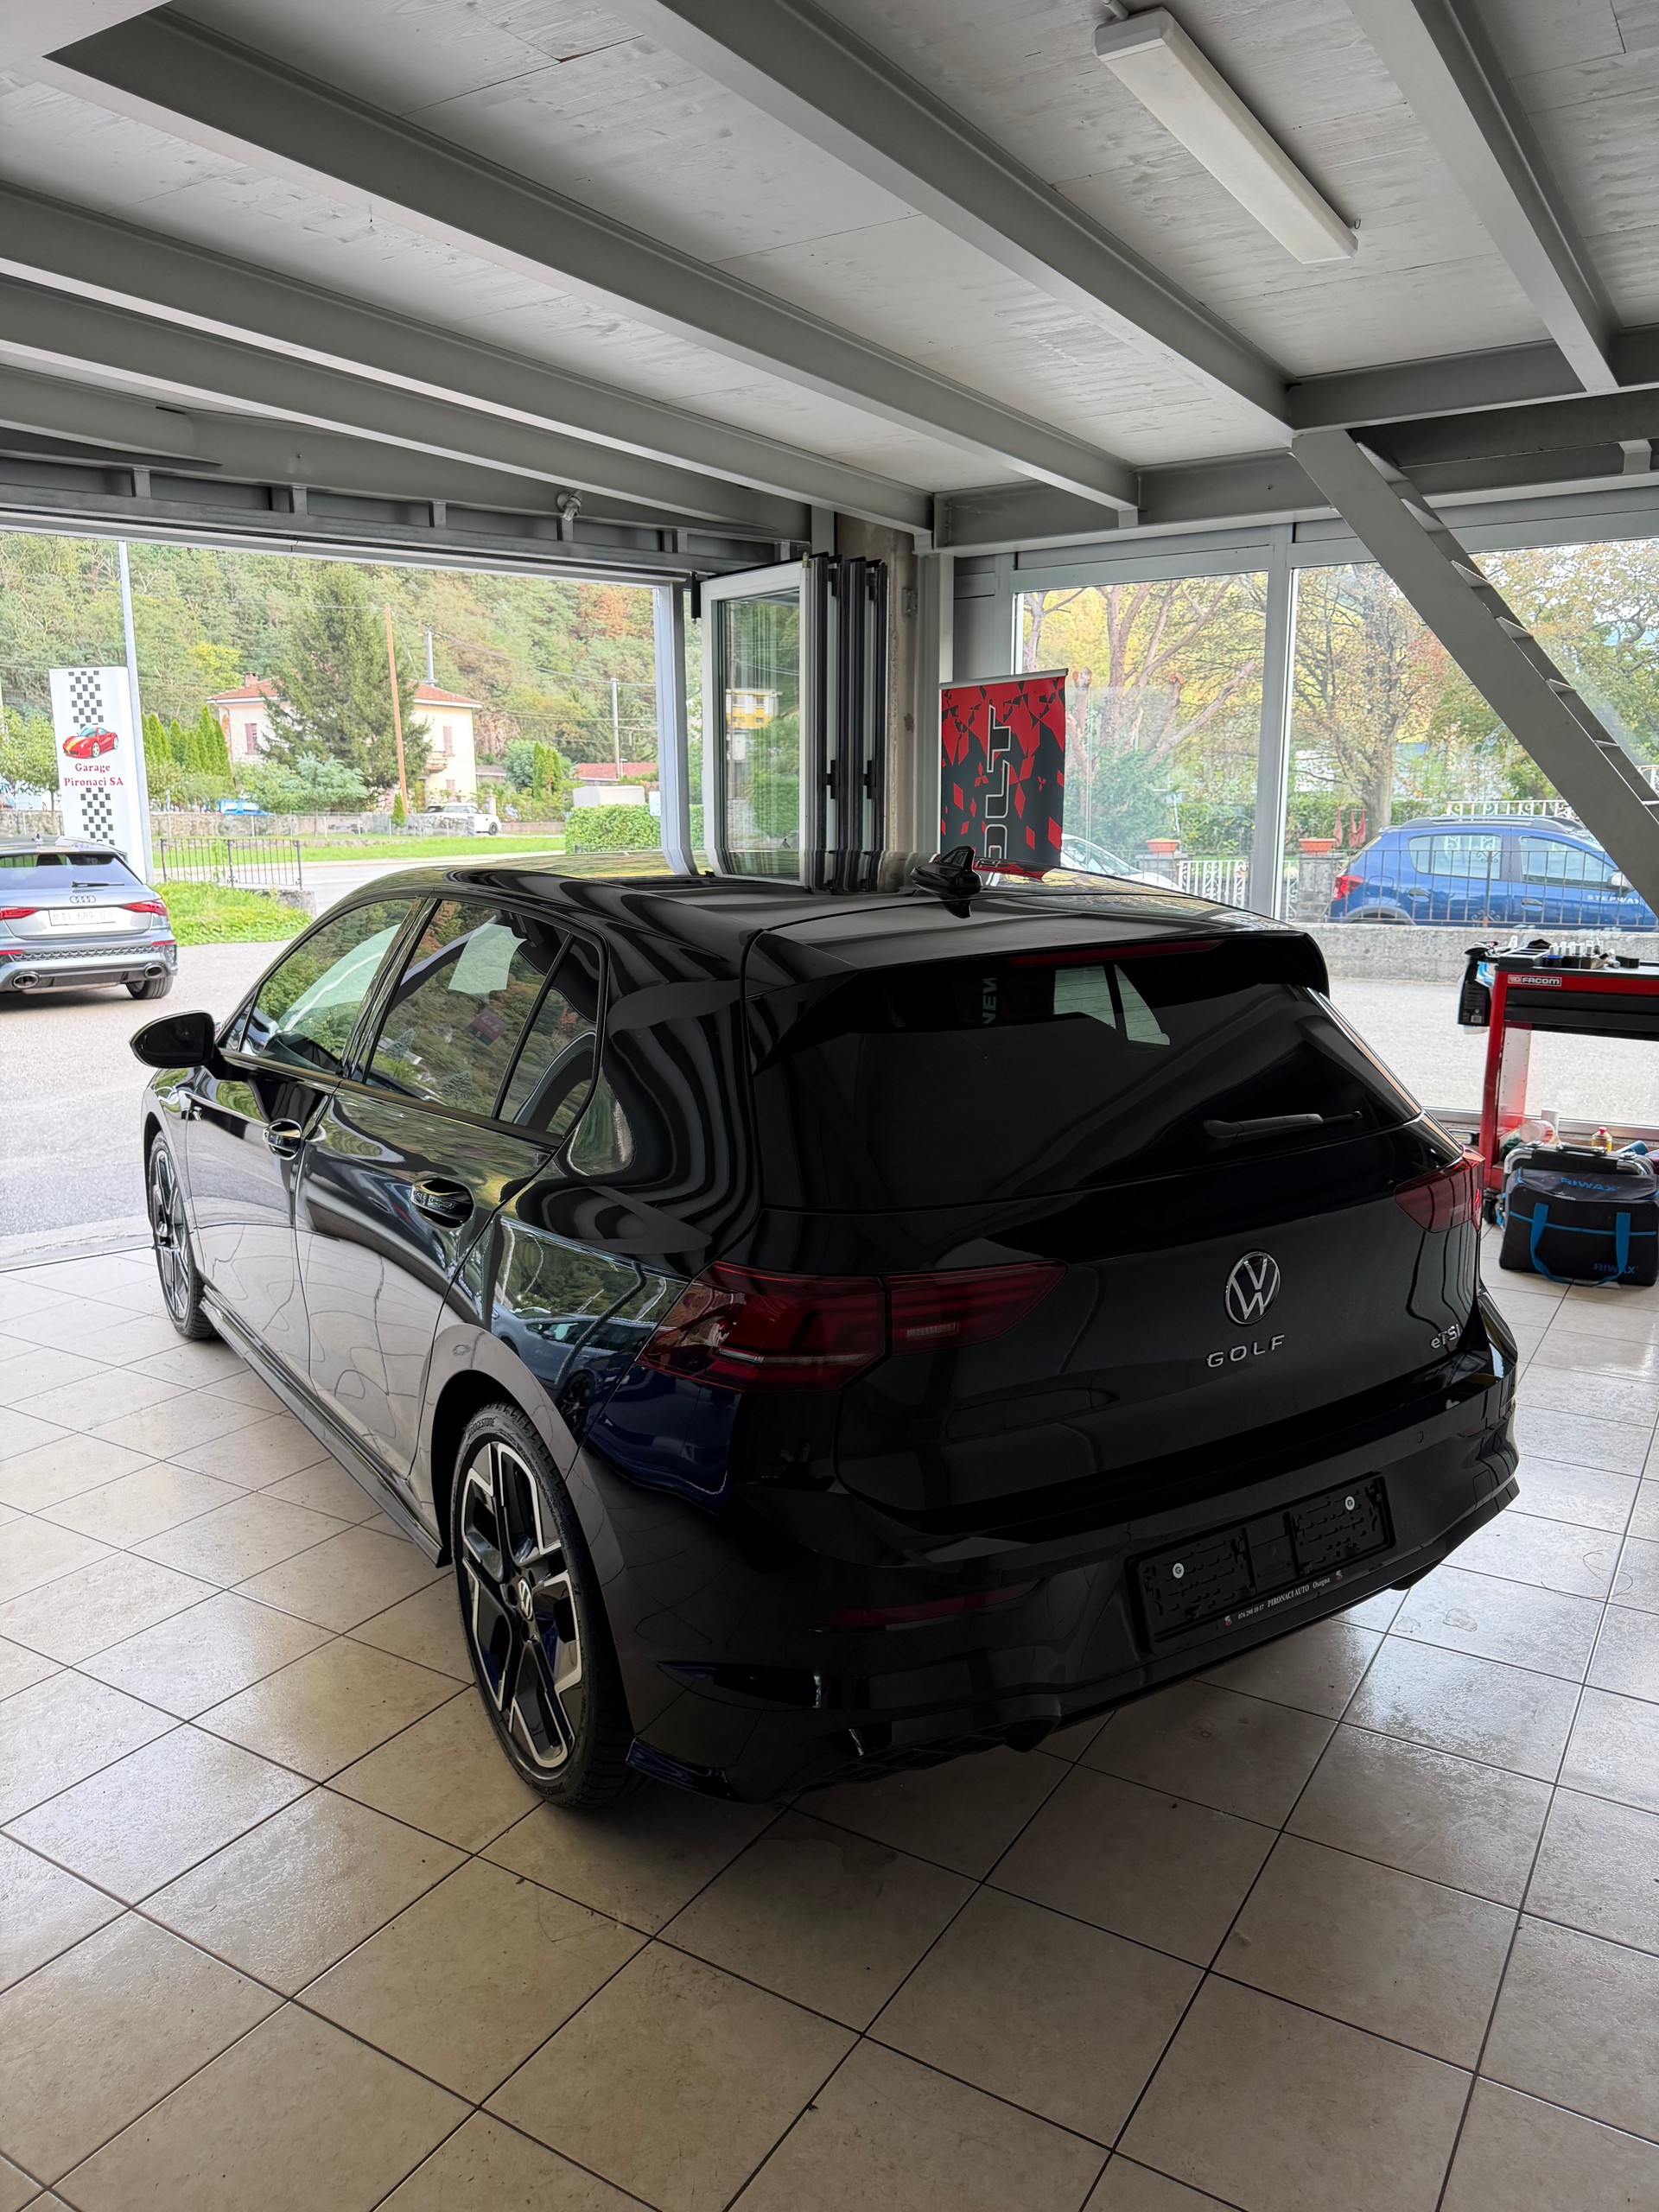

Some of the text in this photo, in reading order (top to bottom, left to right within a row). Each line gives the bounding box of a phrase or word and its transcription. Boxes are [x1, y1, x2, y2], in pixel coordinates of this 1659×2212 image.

[75, 763, 111, 773] Garage
[64, 777, 124, 786] Pironaci SA
[1586, 894, 1639, 904] STEPWAY
[1522, 976, 1560, 985] FACOM
[1560, 1177, 1618, 1192] RIWAX
[1430, 1324, 1461, 1349] eTSI
[1206, 1333, 1286, 1368] GOLF
[1267, 1590, 1294, 1608] PIRONACI
[1294, 1584, 1310, 1597] AUTO
[1313, 1577, 1331, 1589] Osogna
